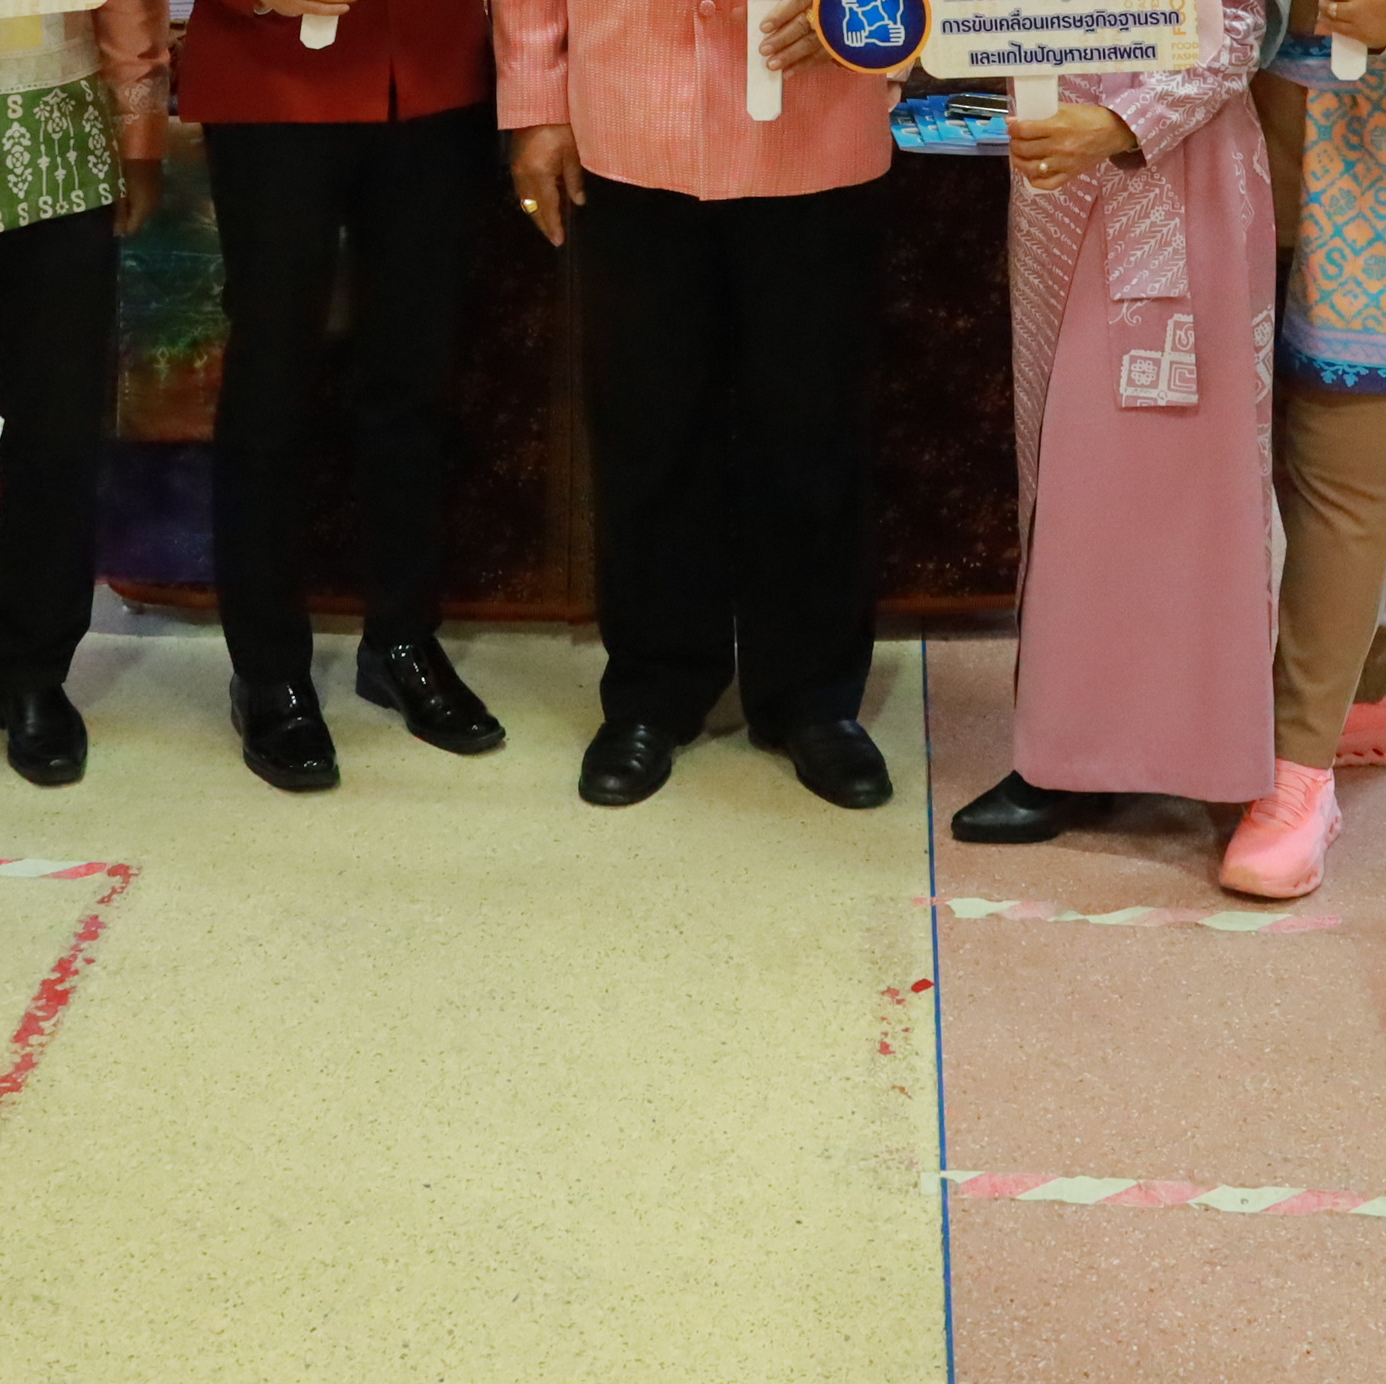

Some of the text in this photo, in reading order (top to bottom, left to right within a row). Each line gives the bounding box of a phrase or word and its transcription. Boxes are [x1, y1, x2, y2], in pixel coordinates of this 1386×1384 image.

[941, 10, 1181, 34] การขับเคลื่อนเศรษฐกิจฐานราก
[969, 41, 1158, 67] และแก้ไขปัญหายาเสพติด
